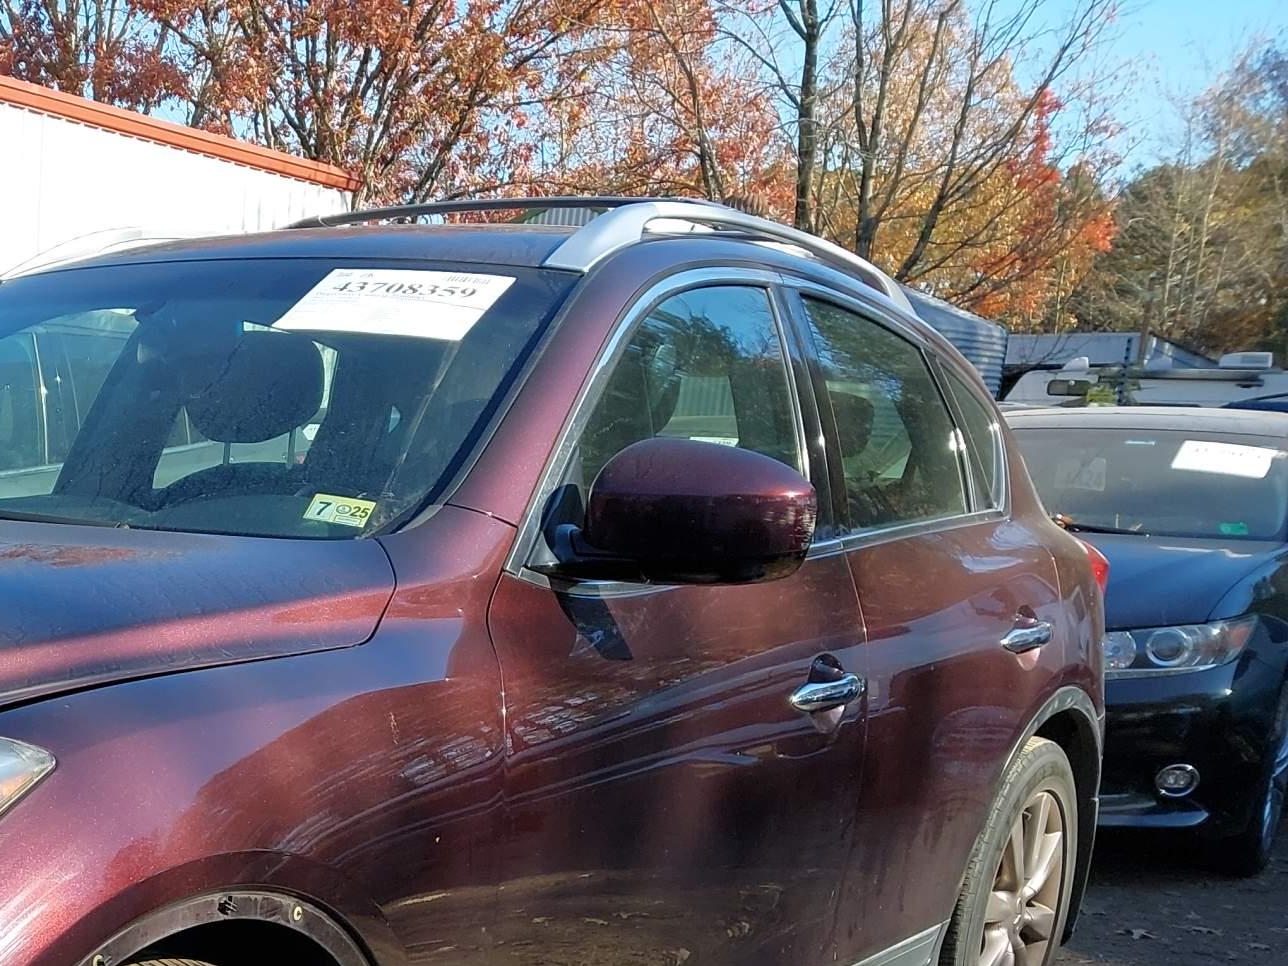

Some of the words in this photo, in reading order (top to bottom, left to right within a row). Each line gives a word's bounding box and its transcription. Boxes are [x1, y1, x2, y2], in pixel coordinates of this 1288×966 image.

[332, 280, 478, 298] 43708359
[316, 501, 332, 516] 7
[349, 506, 370, 519] 25
